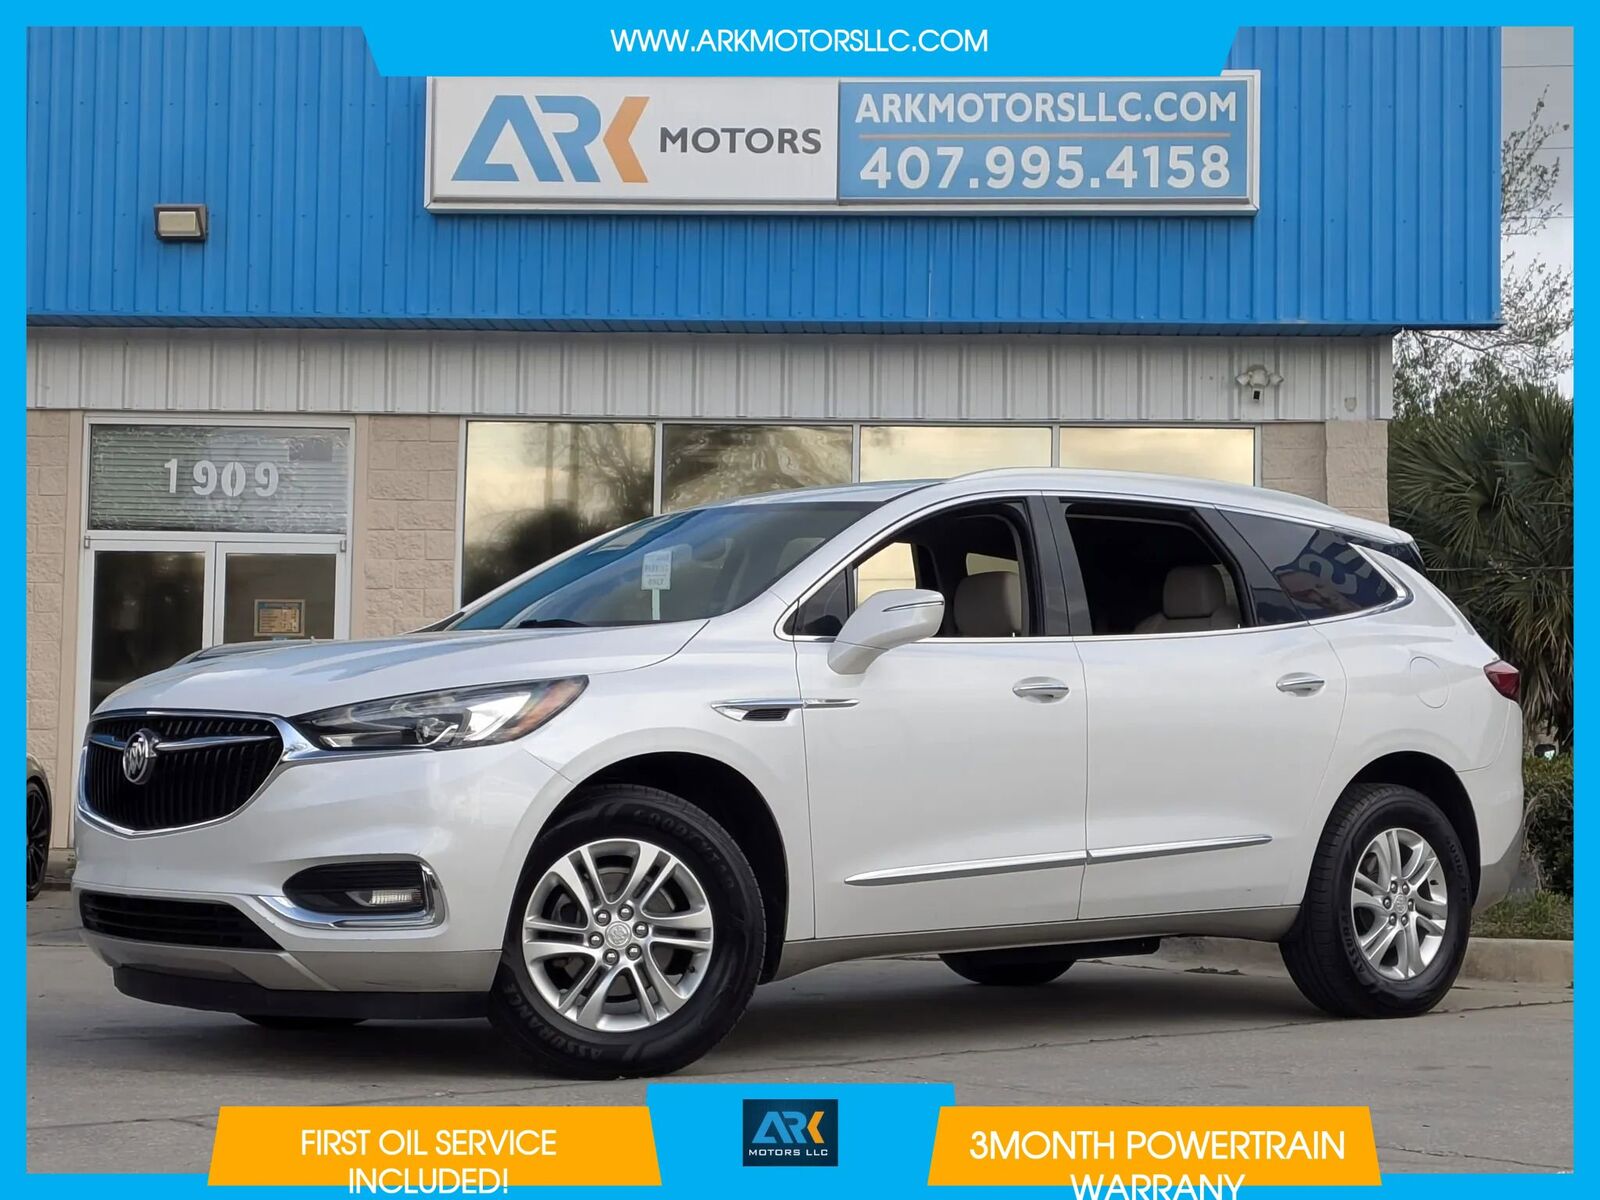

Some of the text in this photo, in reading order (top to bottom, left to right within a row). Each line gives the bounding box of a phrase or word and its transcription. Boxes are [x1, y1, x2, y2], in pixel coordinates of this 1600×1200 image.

[855, 91, 1237, 124] ARKMOTORSLLC.COM
[452, 95, 822, 184] ARK MOTORS
[859, 145, 1231, 190] 407.995.4158
[164, 458, 279, 497] 1909
[502, 982, 603, 1060] ASSURANCE
